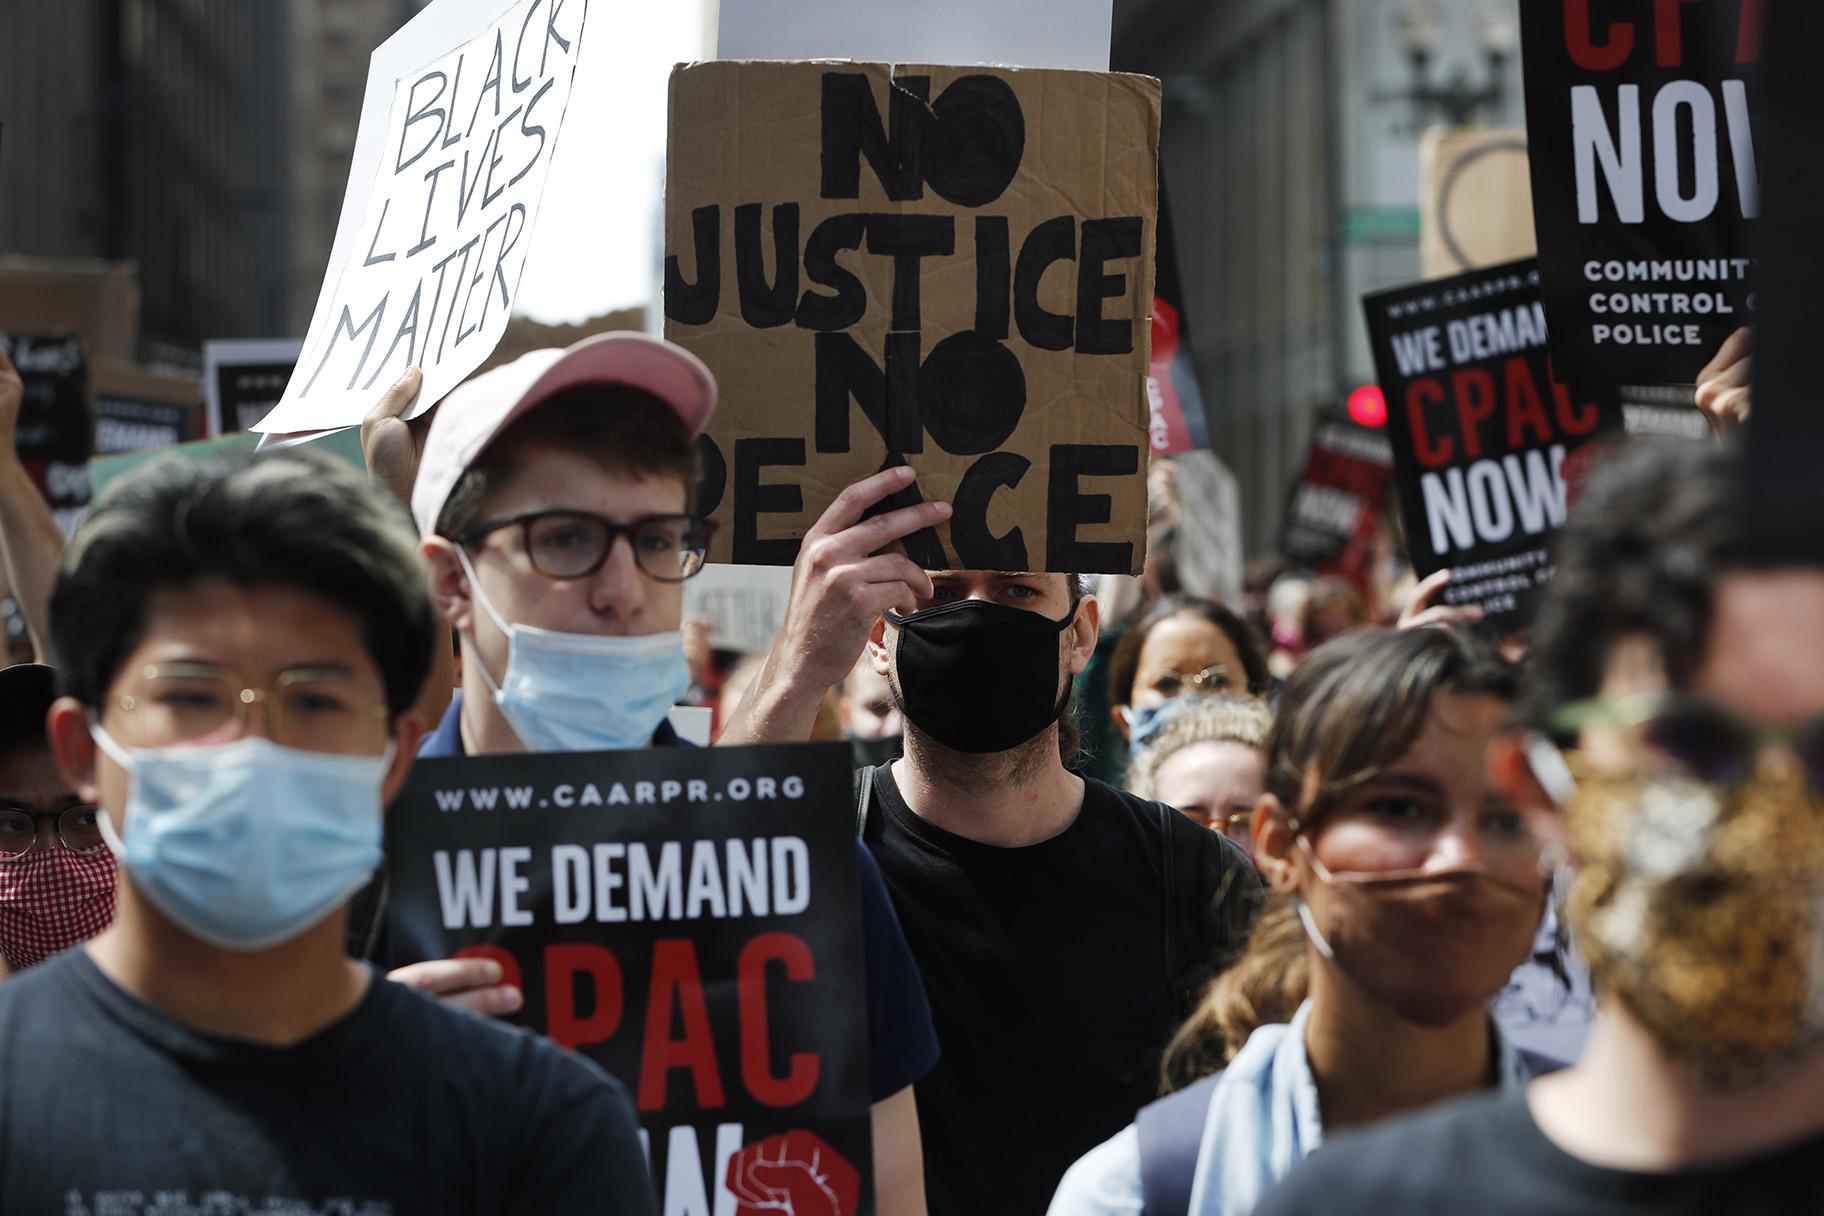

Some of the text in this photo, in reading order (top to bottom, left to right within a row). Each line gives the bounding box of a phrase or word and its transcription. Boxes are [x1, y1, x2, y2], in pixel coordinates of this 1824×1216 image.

[395, 0, 571, 175] BLACK
[820, 72, 1025, 207] NO
[363, 76, 554, 267] LIVES
[298, 202, 526, 398] MATTER
[664, 201, 1143, 355] JUSTICE
[1583, 259, 1757, 281] COMMUNIT
[1588, 293, 1734, 314] CONTROL
[1390, 326, 1445, 377] WE
[1592, 323, 1702, 345] POLICE
[815, 330, 1027, 456] NO
[1420, 444, 1567, 555] NOW
[434, 776, 805, 812] WWW.CAARPR.ORG
[433, 836, 811, 929] WE DEMAND
